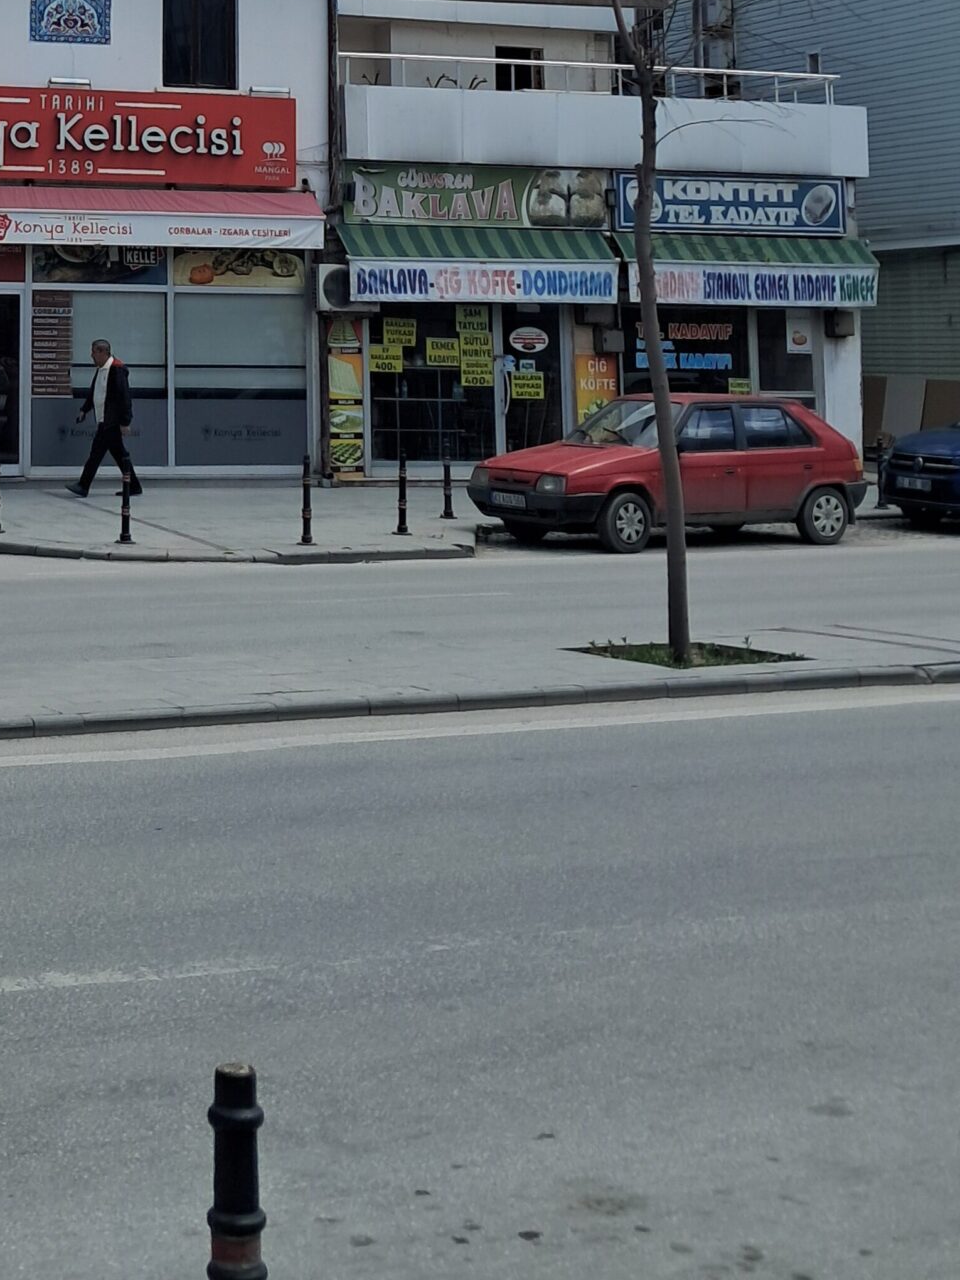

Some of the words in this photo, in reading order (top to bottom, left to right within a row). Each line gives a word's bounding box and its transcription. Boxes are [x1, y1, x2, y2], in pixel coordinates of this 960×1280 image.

[56, 112, 244, 156] Kellecisi
[47, 158, 94, 175] 1389
[254, 166, 291, 175] MANGAL
[352, 171, 518, 220] BAKLAVA
[663, 180, 799, 203] KONTAT
[665, 204, 706, 225] TEL
[710, 206, 800, 226] KADAYIF
[13, 221, 64, 239] Konya
[72, 222, 133, 235] Kellecisi
[168, 227, 213, 236] ÇORBALAR
[126, 251, 156, 264] KELLE
[754, 273, 790, 301] EKMEK
[793, 274, 837, 301] KADAYIF
[839, 274, 875, 302] KÜNEFE
[668, 323, 733, 340] KADAYIF
[431, 341, 456, 351] EKMEK
[588, 357, 607, 376] ÇİĞ
[580, 376, 617, 391] KÖFTE
